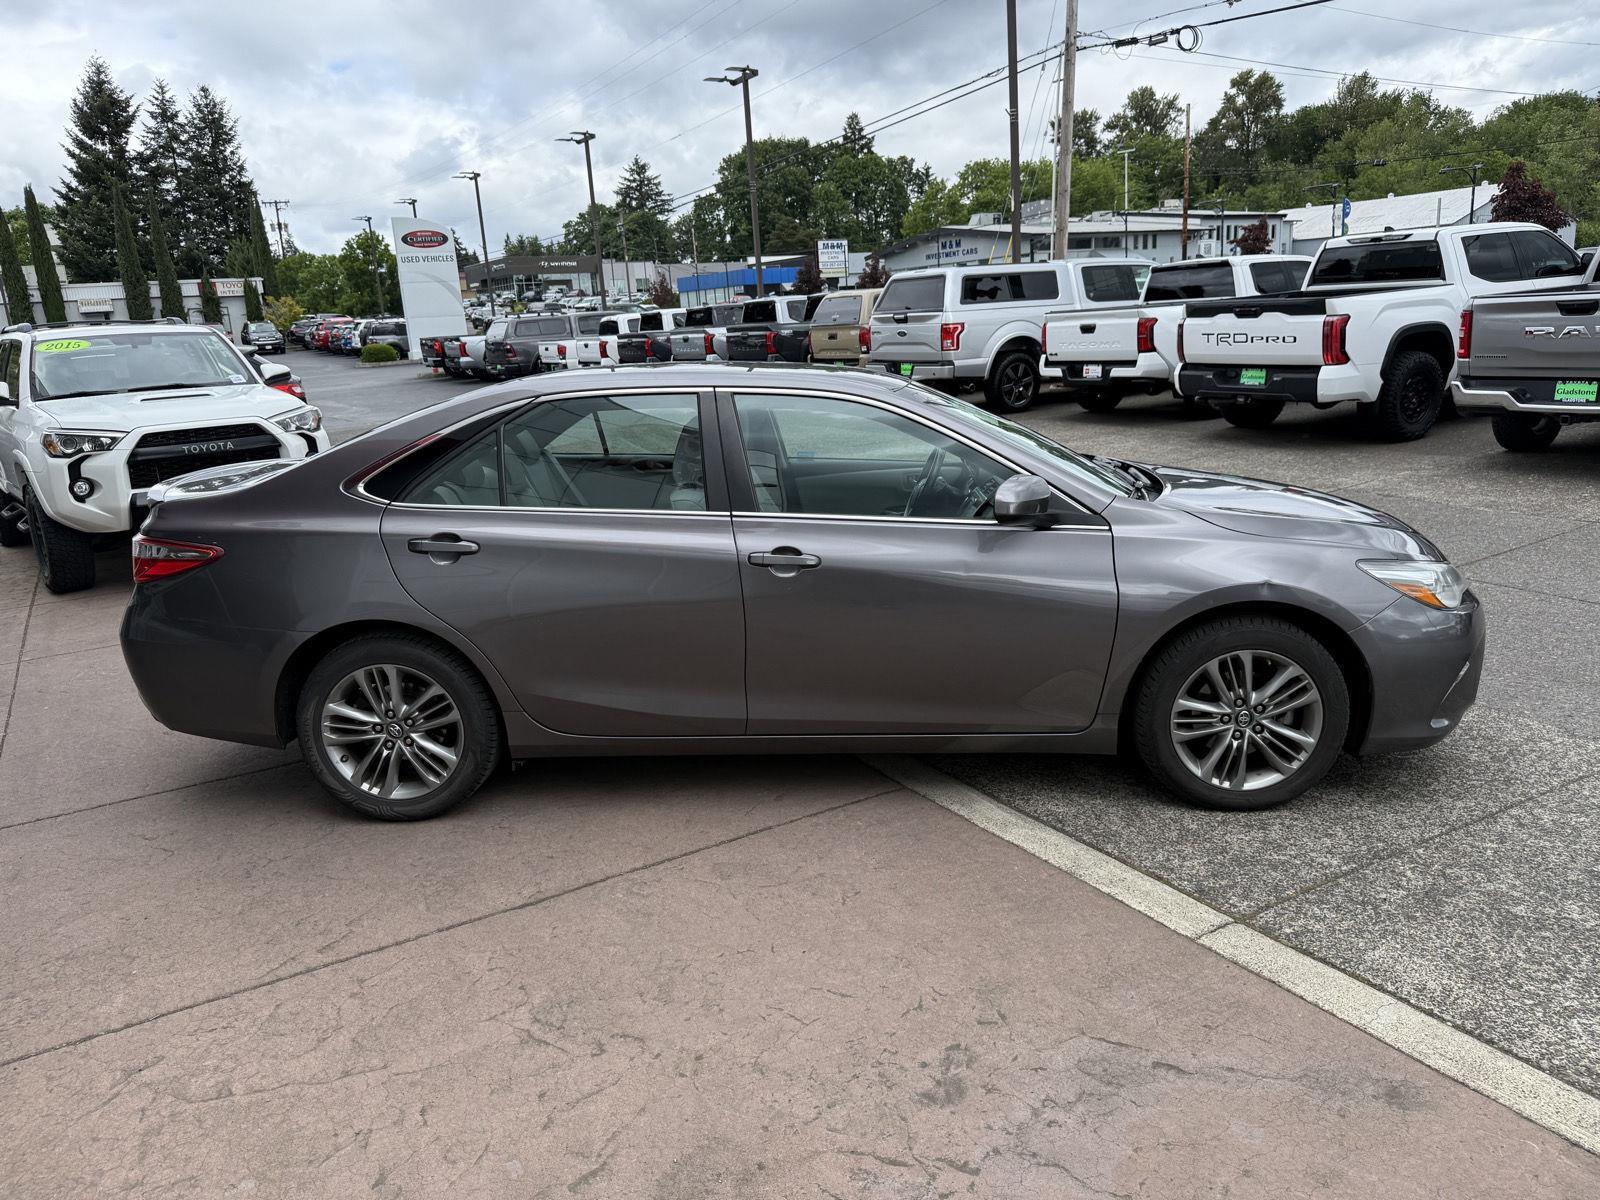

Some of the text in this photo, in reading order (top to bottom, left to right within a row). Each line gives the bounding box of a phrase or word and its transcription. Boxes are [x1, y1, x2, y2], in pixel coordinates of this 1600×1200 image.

[400, 254, 455, 264] USED VEHICLES
[925, 248, 978, 260] INVESTMENT CARS
[1524, 326, 1600, 339] RA
[44, 341, 81, 351] 2015
[1058, 341, 1121, 350] TACOMA
[1556, 388, 1596, 396] Gladstone
[182, 441, 235, 455] TOYOTA
